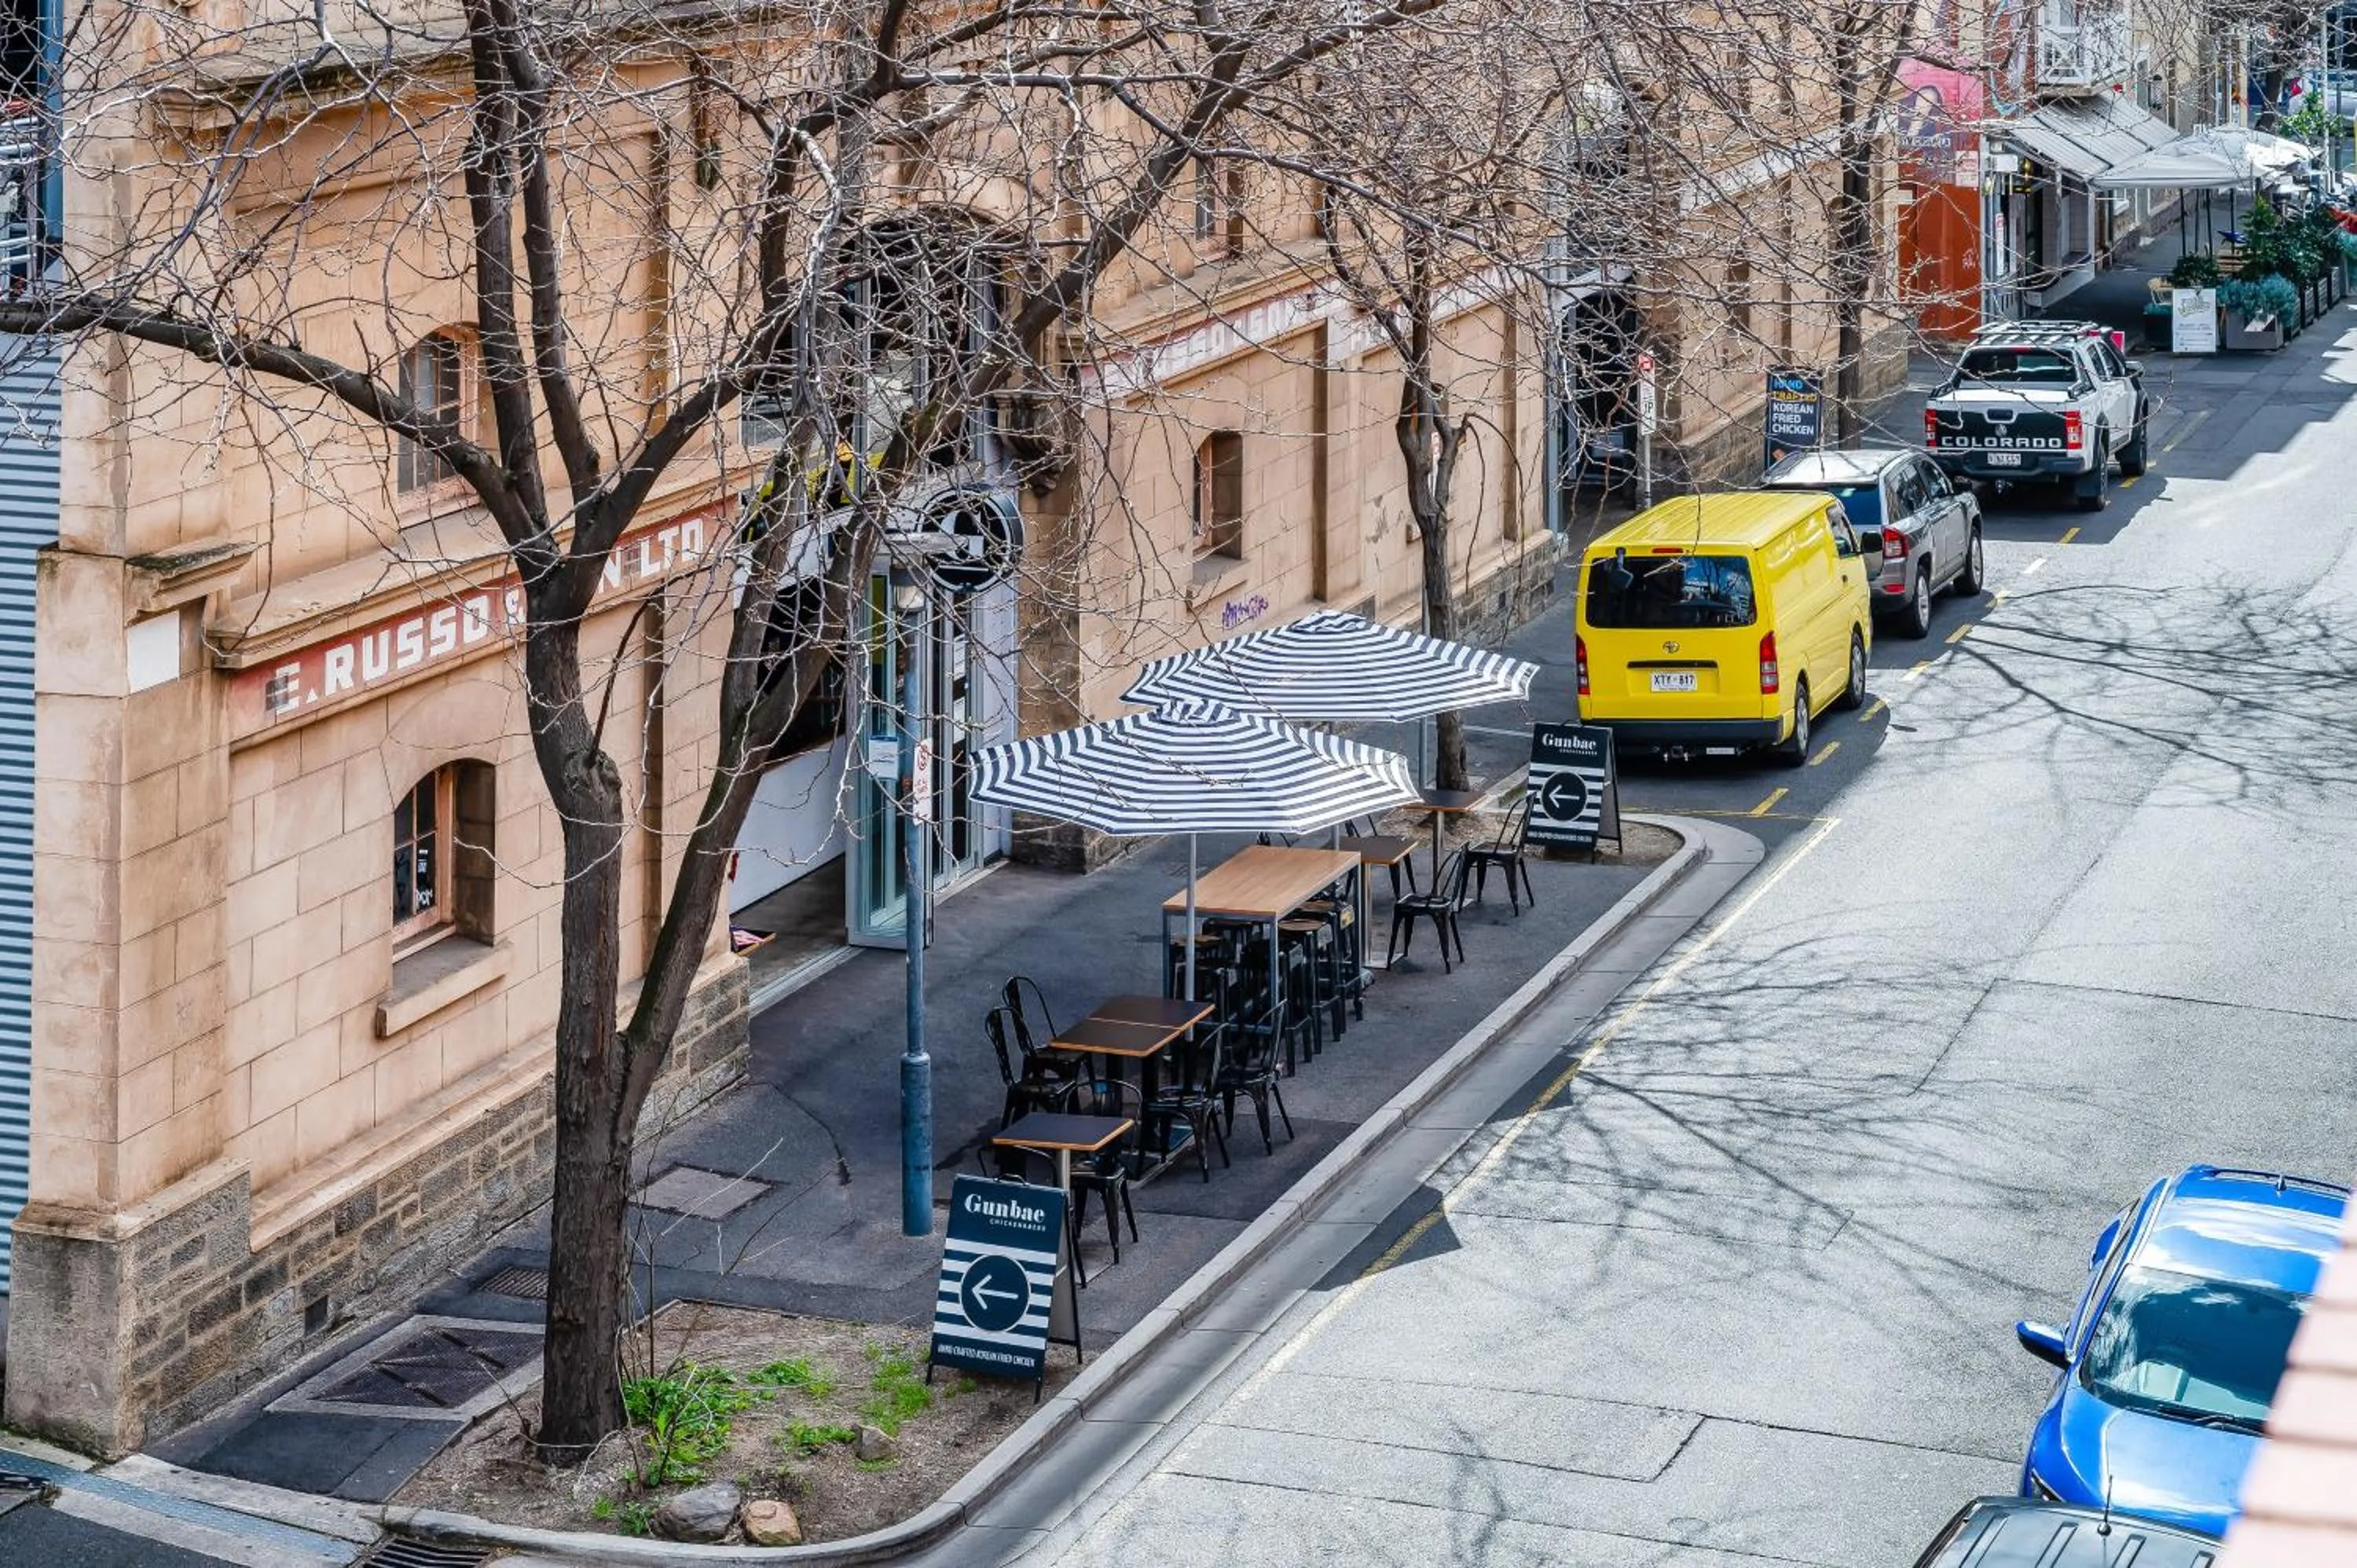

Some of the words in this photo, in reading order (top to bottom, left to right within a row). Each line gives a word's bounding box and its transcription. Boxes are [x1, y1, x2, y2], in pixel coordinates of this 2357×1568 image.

[1772, 402, 1814, 414] KOREAN
[1772, 412, 1802, 423] FRIED
[1772, 424, 1814, 435] CHICKEN
[1941, 436, 2062, 449] COLORADO
[1542, 733, 1596, 750] Gunbae
[964, 1193, 1046, 1223] Gunbae
